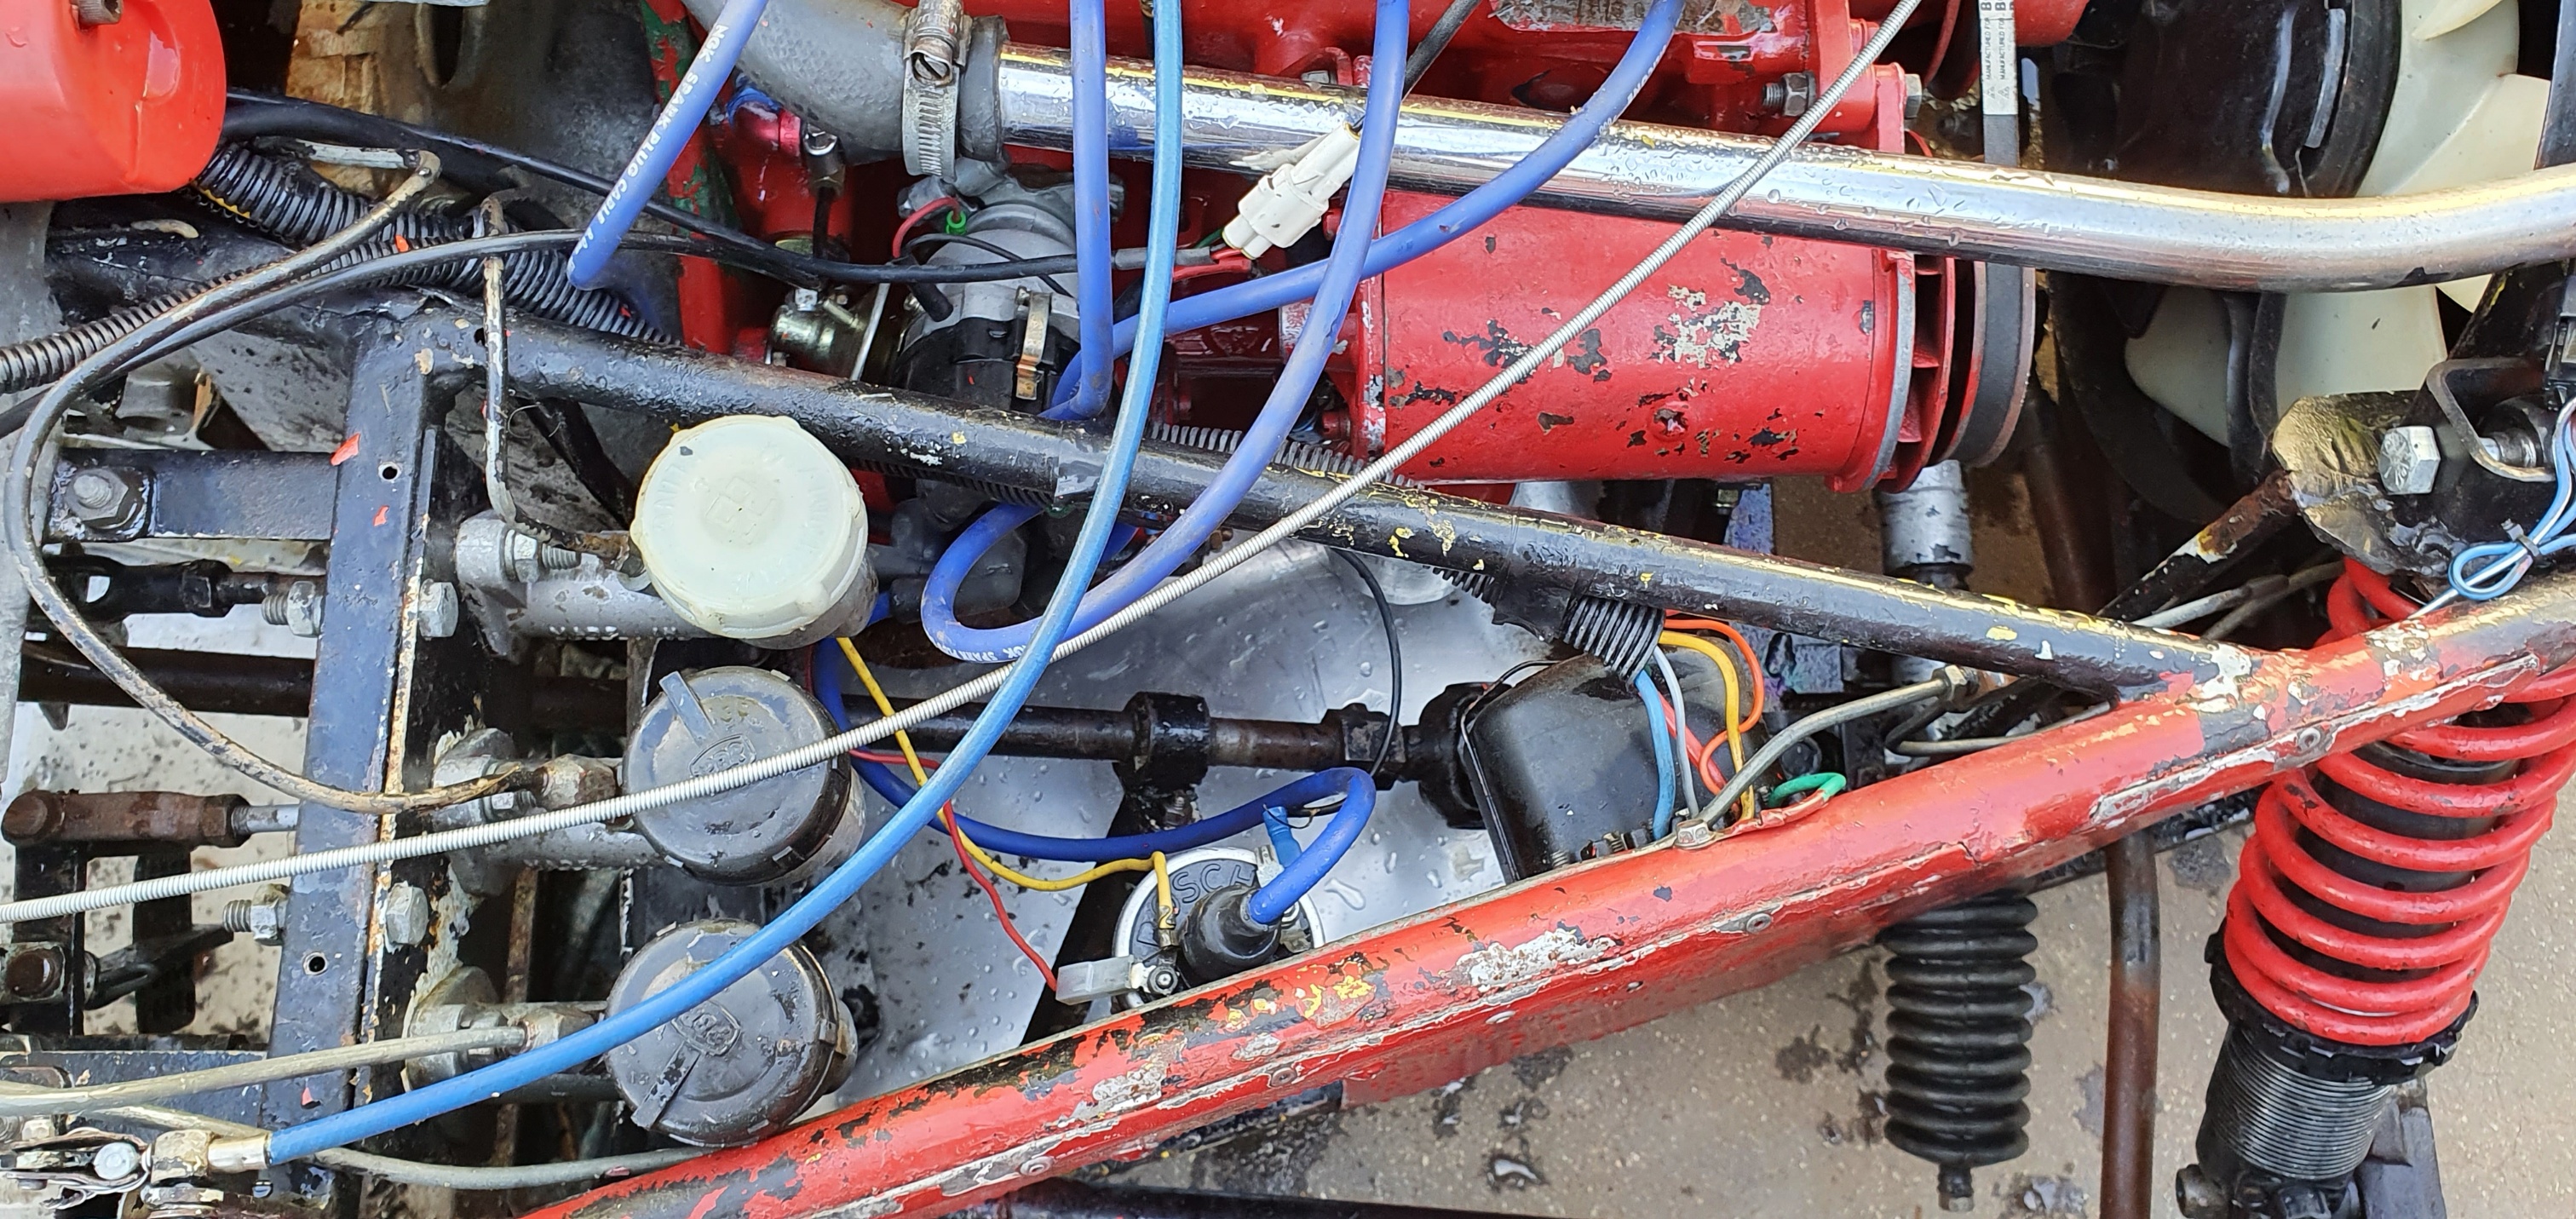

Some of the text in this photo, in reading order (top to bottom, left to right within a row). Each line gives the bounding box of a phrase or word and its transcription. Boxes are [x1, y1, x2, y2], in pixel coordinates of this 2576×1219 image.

[699, 24, 728, 63] NGK
[657, 72, 699, 130] SPARK
[627, 132, 661, 177] PLUG
[1002, 644, 1026, 659] GK
